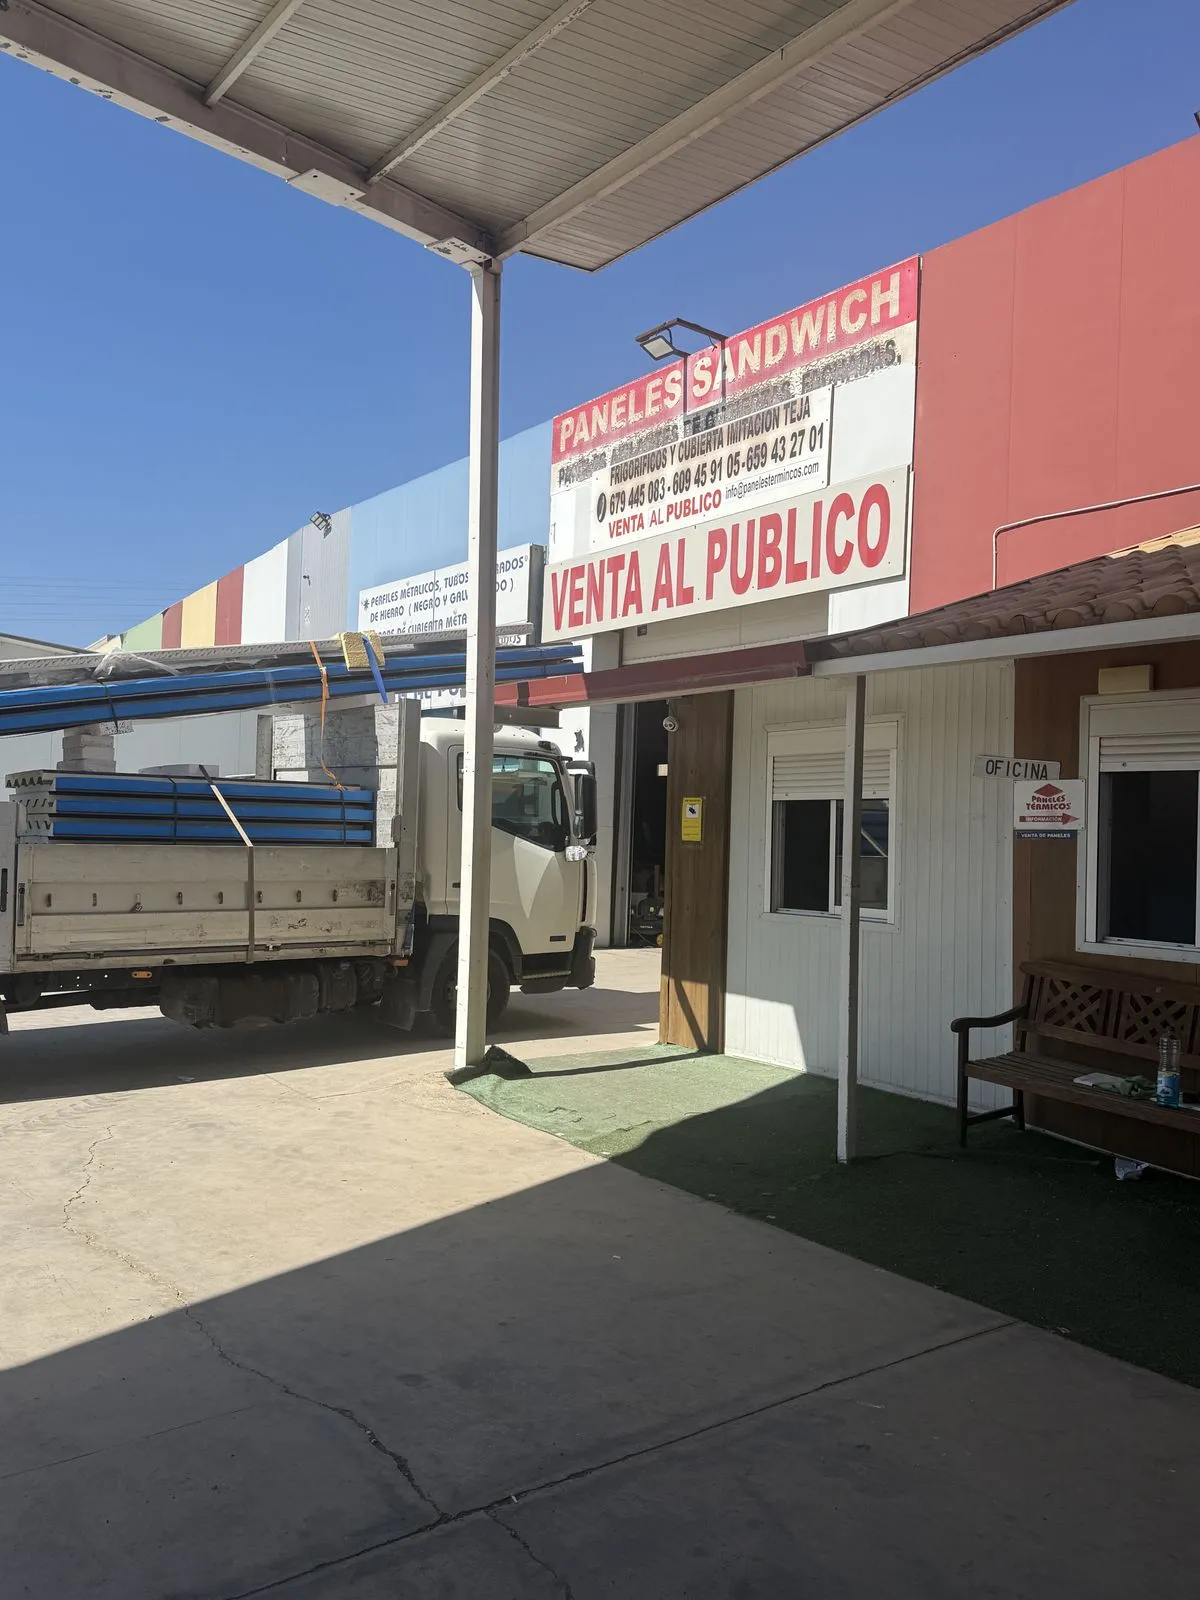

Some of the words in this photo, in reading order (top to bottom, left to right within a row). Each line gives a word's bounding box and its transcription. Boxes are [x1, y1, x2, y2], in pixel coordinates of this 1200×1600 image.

[559, 369, 682, 452] PANELES
[692, 271, 901, 398] SANDWICH
[610, 448, 668, 486] FRIGORIFICOS
[669, 446, 676, 466] Y
[679, 428, 724, 463] CUBIERTA
[727, 407, 780, 446] IMITACION
[783, 396, 811, 427] TEJA
[609, 490, 625, 516] 679
[628, 486, 645, 510] 445
[648, 479, 665, 504] 083
[673, 473, 691, 497] 609
[694, 467, 707, 490] 45
[710, 457, 722, 481] 91
[771, 435, 786, 464] 43
[790, 429, 806, 458] 27
[809, 422, 824, 452] 01
[609, 513, 645, 539] VENTA
[650, 508, 664, 527] AL
[666, 489, 722, 522] PUBLICO
[551, 550, 642, 631] VENTA
[652, 536, 695, 611] AL
[705, 483, 891, 601] PUBLICO
[370, 612, 379, 623] DE
[380, 606, 405, 620] HIERRO
[413, 598, 440, 613] NEGRO
[442, 596, 448, 607] Y
[371, 592, 399, 607] PERFILES
[400, 581, 442, 599] METALICOS,
[444, 571, 469, 588] TUBOS
[445, 612, 468, 631] META
[985, 760, 1049, 780] OFICINA
[1031, 794, 1066, 803] PANELES
